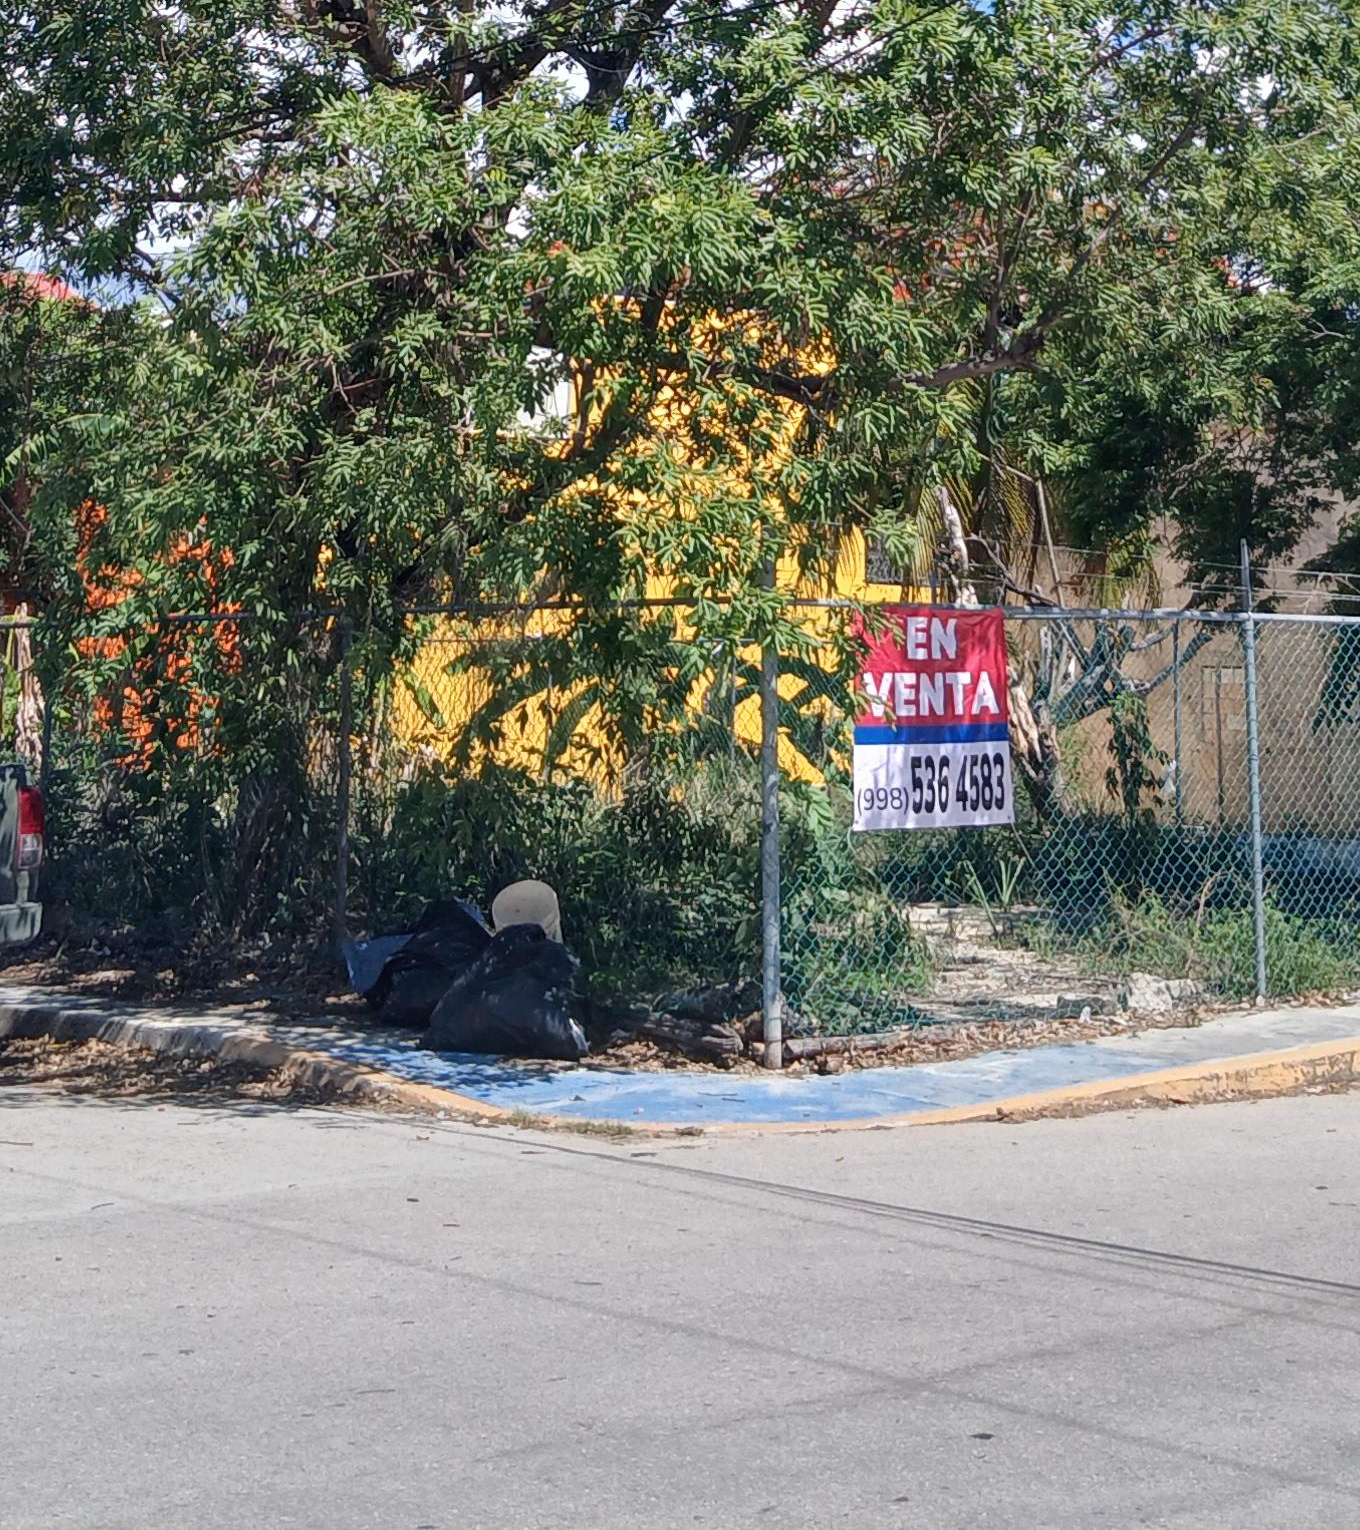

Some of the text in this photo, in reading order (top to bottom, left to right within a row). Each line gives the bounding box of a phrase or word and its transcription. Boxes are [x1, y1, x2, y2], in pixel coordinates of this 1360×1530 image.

[906, 616, 957, 660] EN
[863, 671, 999, 717] VENTA
[857, 752, 1005, 815] (998) 536 4583
